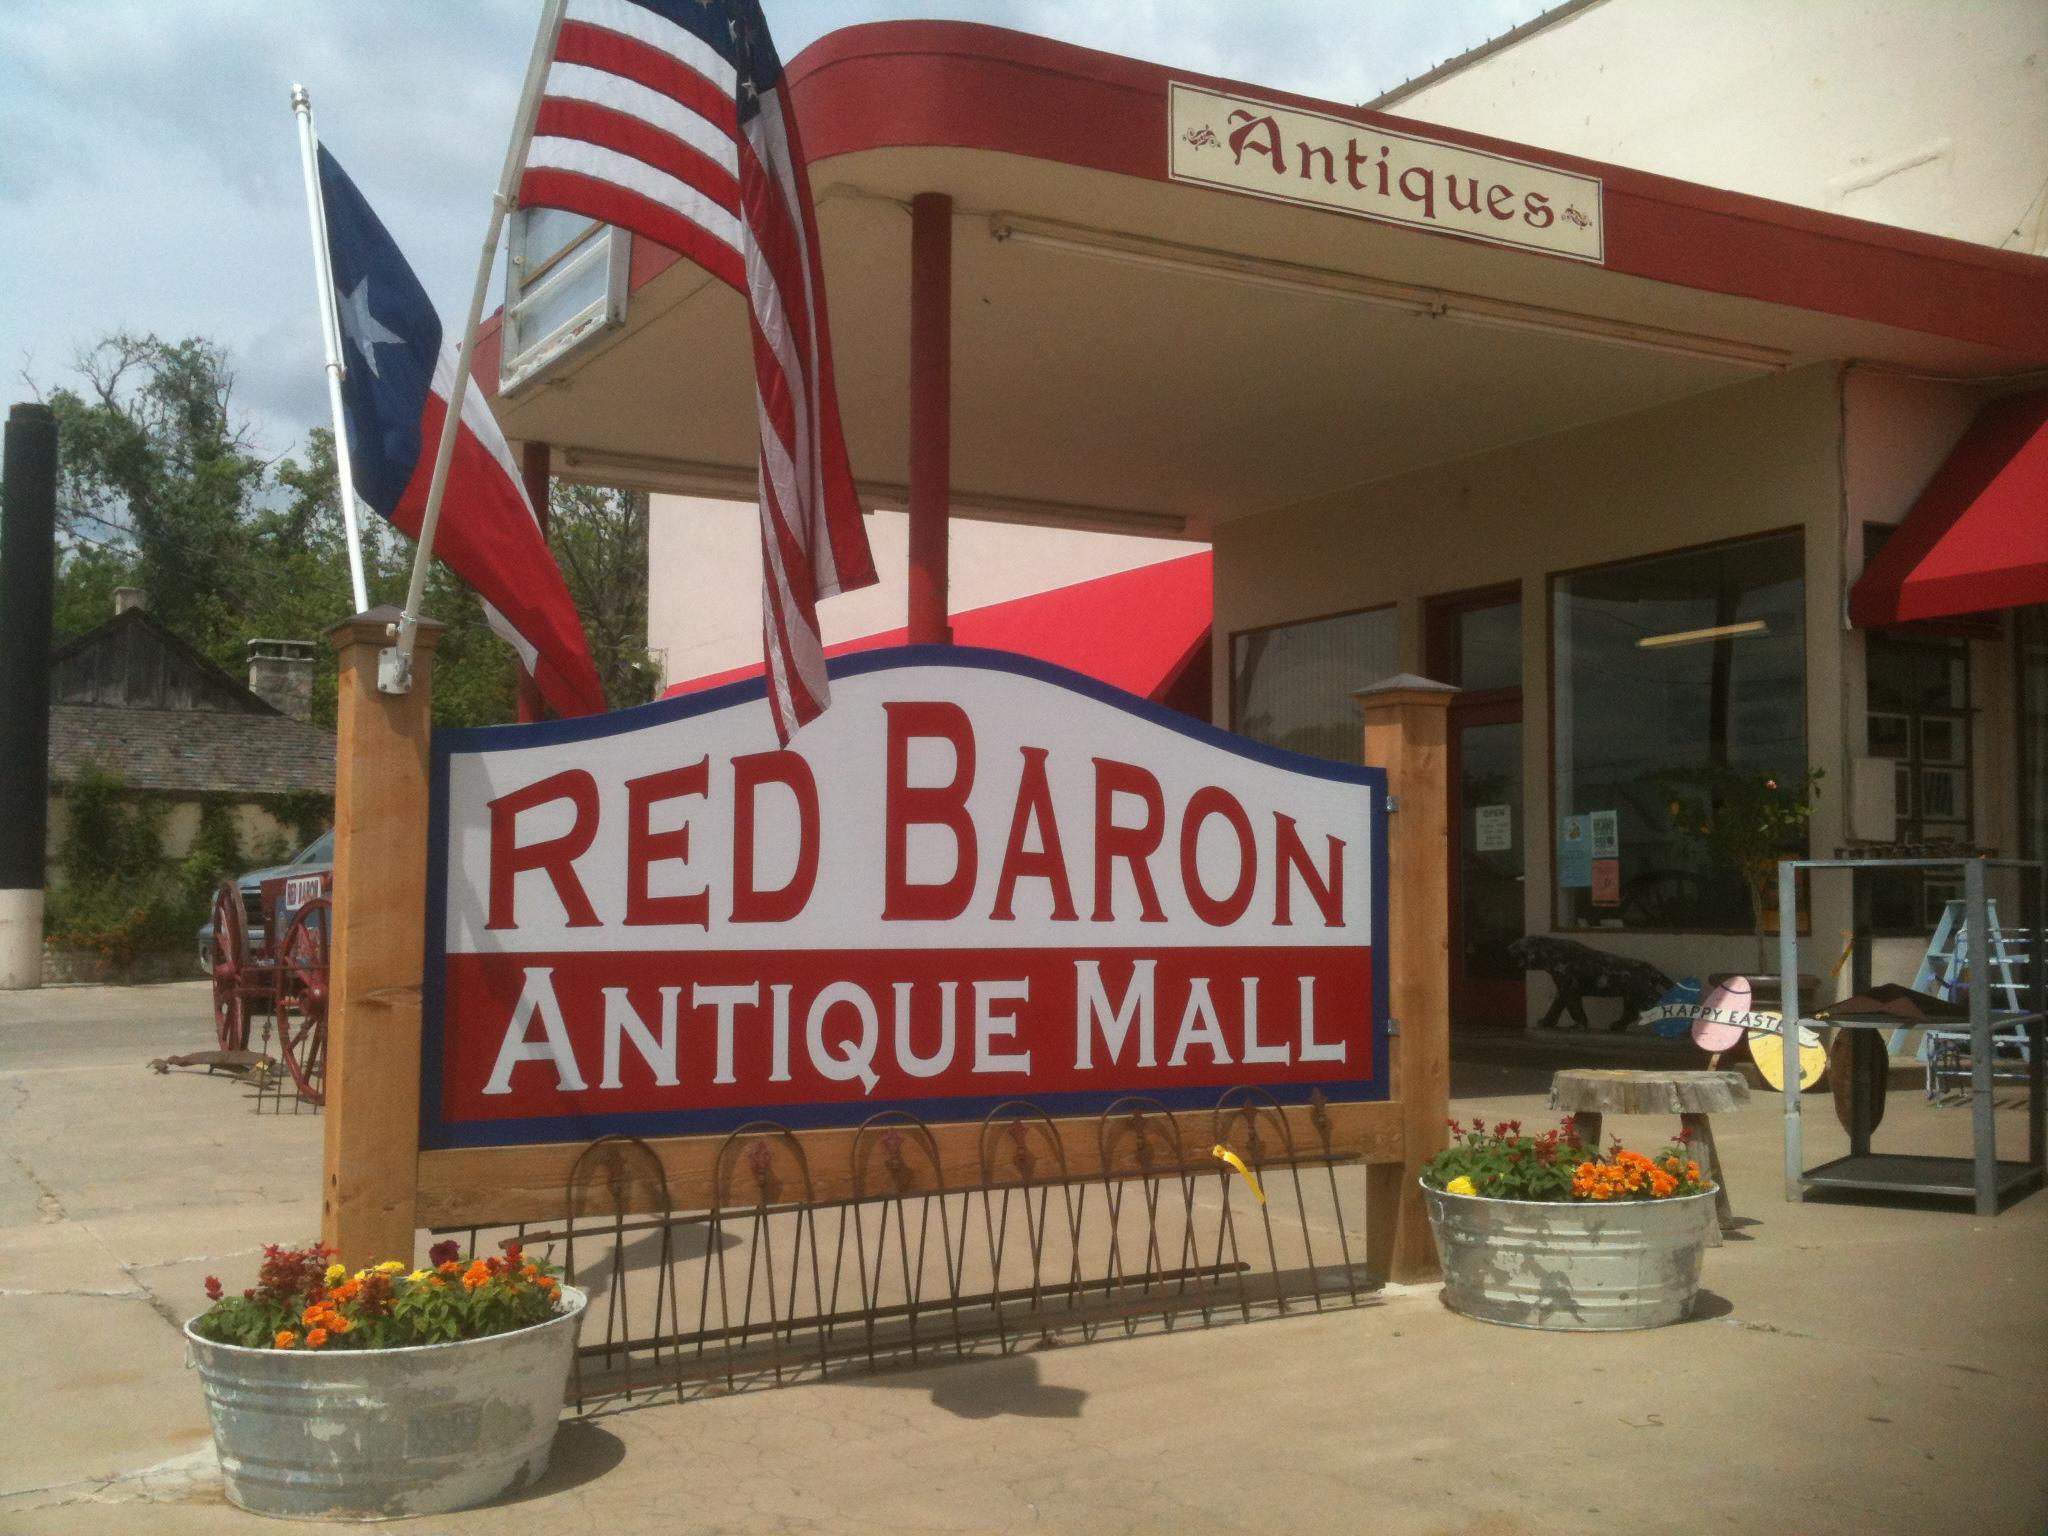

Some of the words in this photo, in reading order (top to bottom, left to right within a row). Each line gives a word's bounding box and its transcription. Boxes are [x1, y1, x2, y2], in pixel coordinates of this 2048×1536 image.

[1227, 109, 1555, 228] Antiques
[484, 750, 820, 932] RED
[881, 702, 1347, 928] BARON
[482, 966, 1031, 1095] ANTIQUE
[1073, 959, 1347, 1070] MALL
[1662, 1005, 1721, 1020] HAPPY
